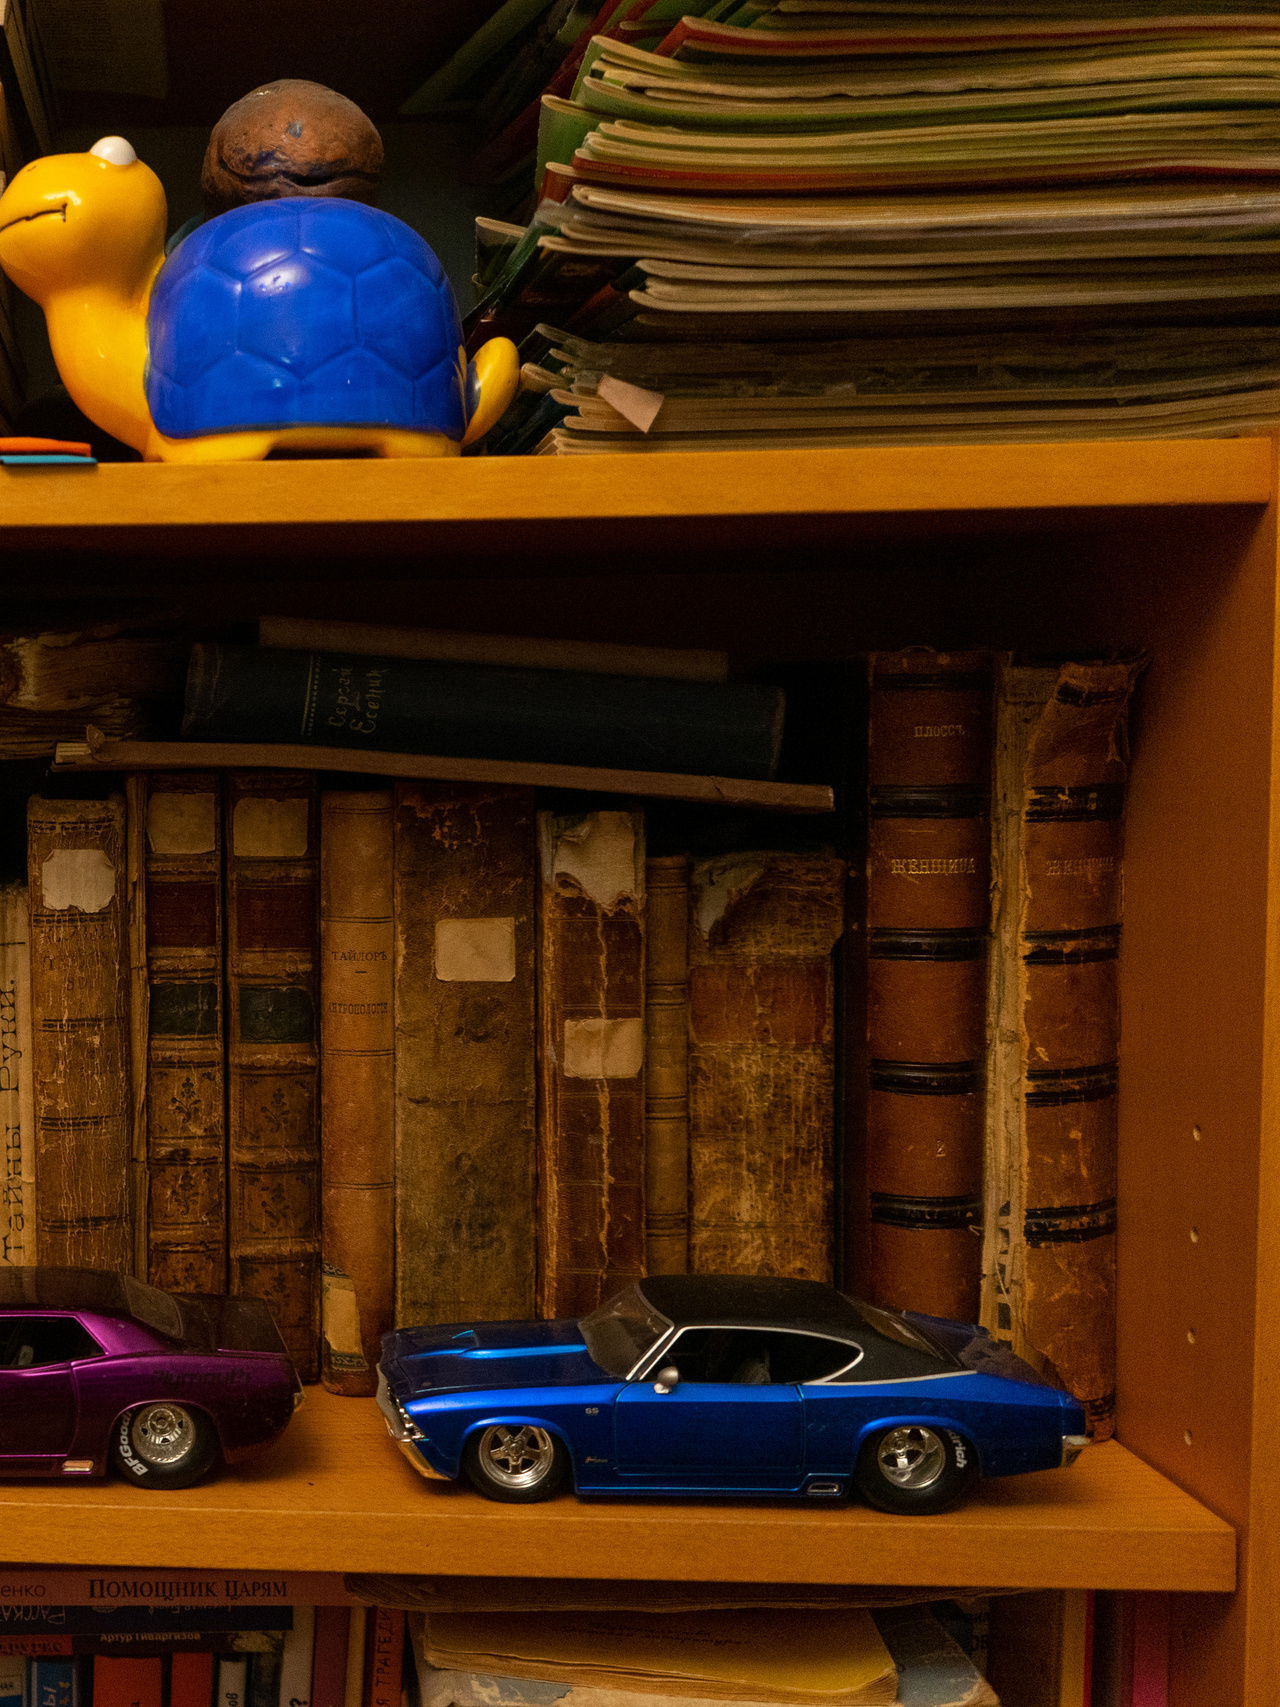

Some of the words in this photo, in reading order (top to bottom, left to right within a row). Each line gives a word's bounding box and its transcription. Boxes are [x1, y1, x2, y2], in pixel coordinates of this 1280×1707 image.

[331, 949, 388, 962] ТАЙЛОРЪ
[3, 1122, 25, 1264] Тайны
[224, 1580, 288, 1601] ЦАРЯМ
[375, 1609, 395, 1689] ТРАГЕДИ
